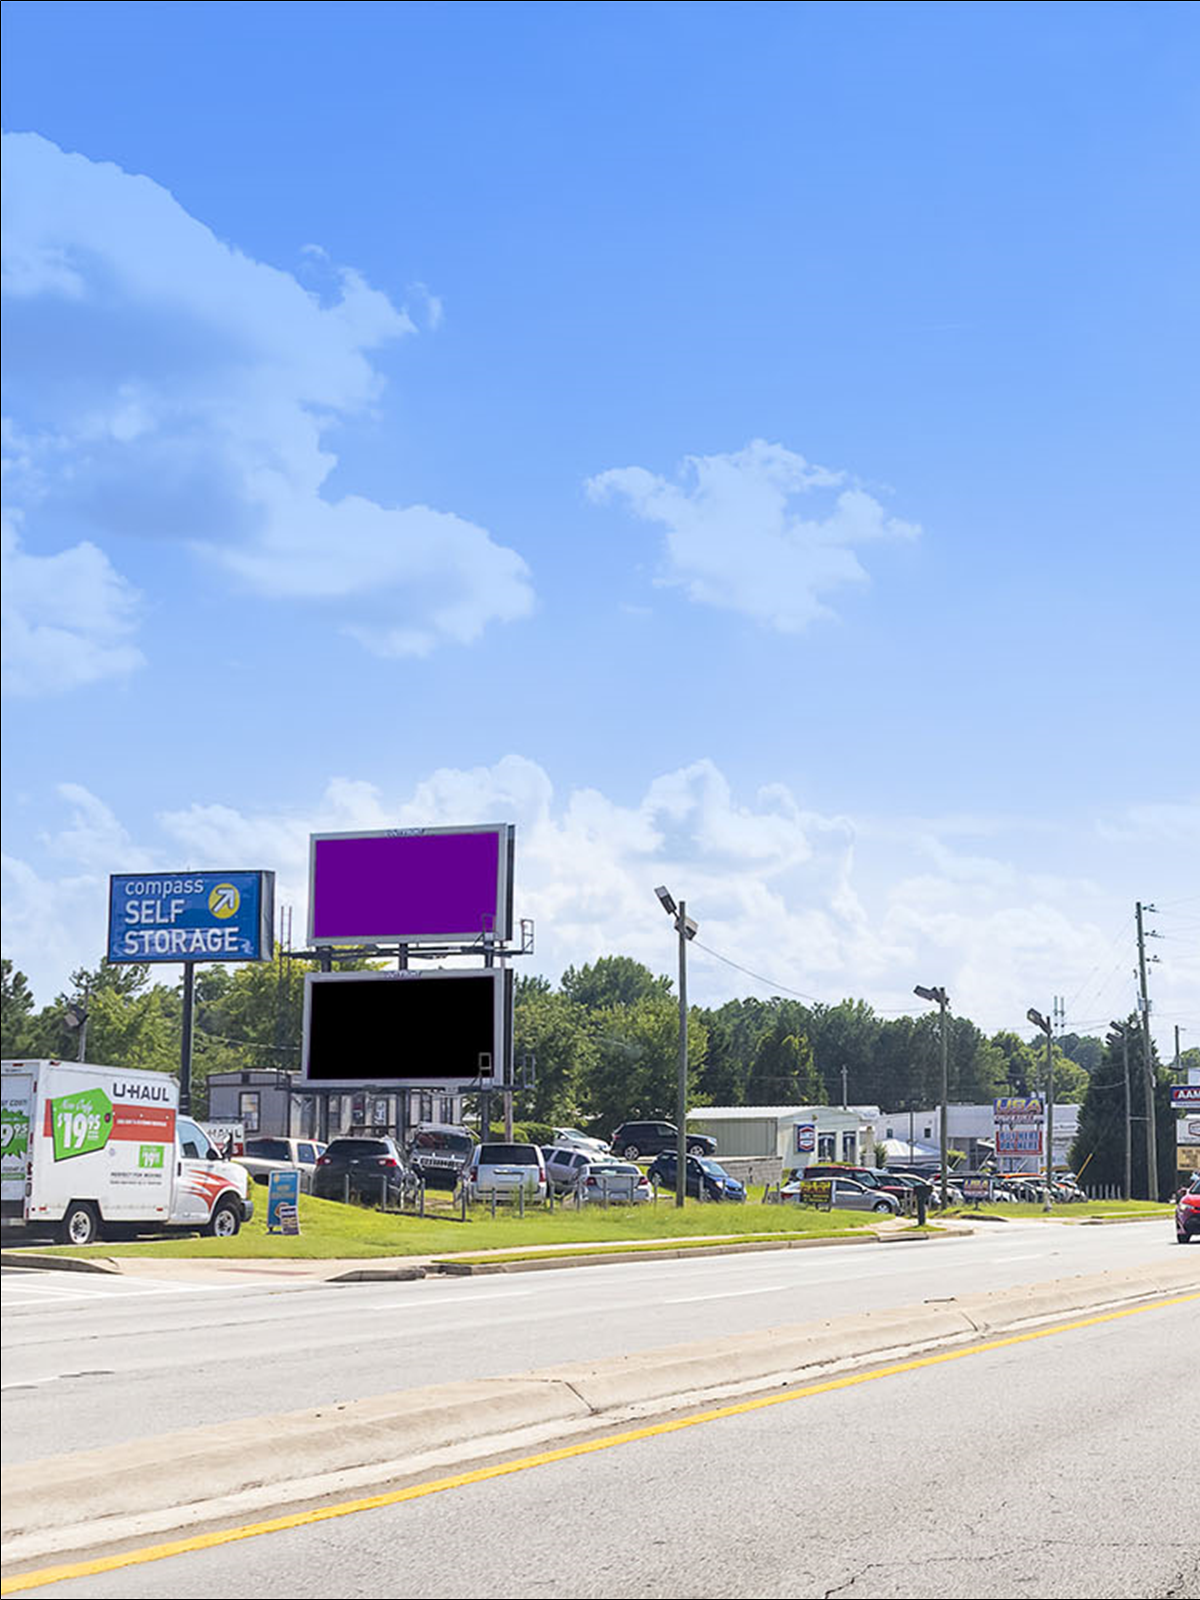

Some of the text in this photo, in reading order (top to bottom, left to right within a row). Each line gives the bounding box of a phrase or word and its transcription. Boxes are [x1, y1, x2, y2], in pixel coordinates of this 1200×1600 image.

[125, 879, 204, 899] compass
[125, 899, 185, 924] SELF
[125, 927, 240, 955] STORAGE
[112, 1082, 170, 1102] U-HAUL
[996, 1099, 1042, 1114] USA
